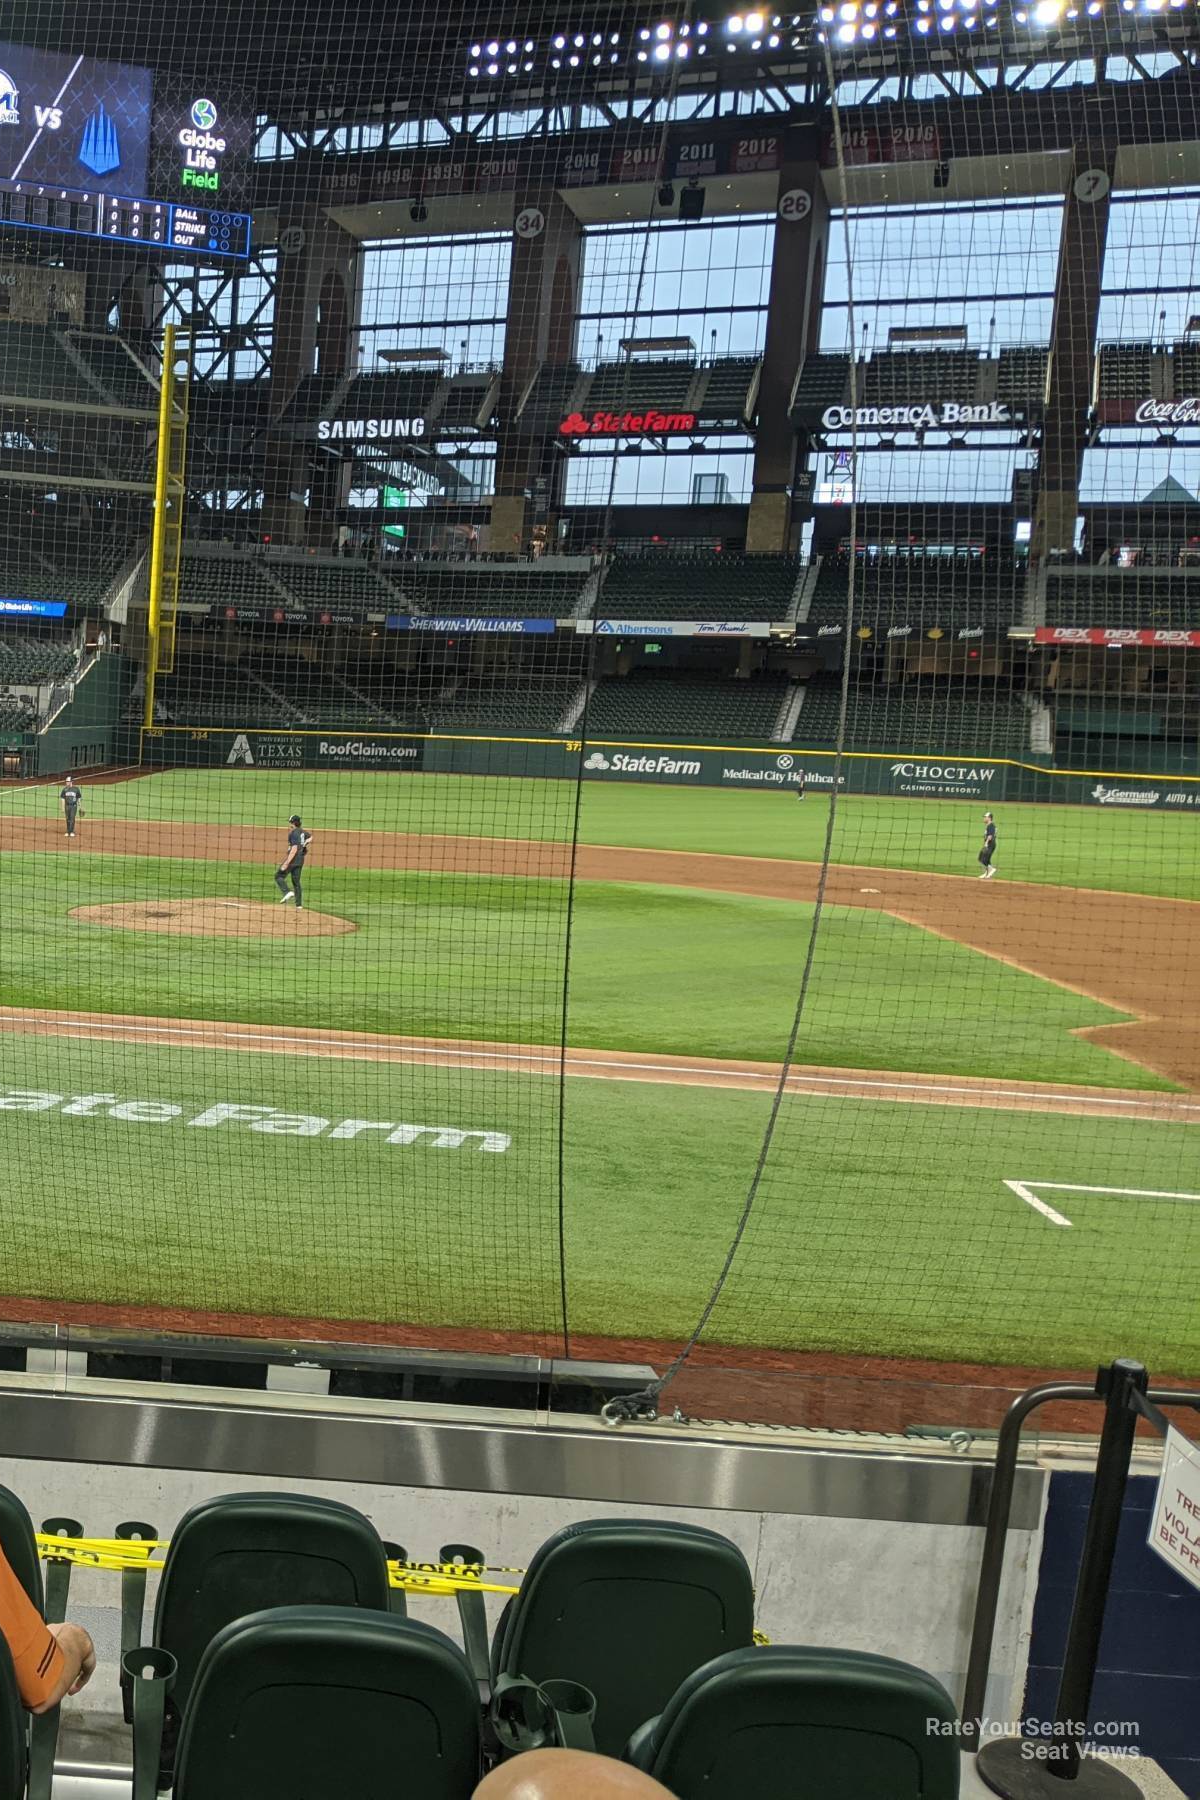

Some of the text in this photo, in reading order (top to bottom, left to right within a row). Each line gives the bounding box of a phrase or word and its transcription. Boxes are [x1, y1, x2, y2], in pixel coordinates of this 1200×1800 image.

[34, 104, 63, 130] VS
[179, 128, 226, 152] Globe
[829, 129, 869, 149] 2015
[893, 125, 935, 144] 2016
[679, 143, 716, 161] 2011
[738, 137, 777, 155] 2012
[186, 148, 217, 170] Life
[481, 159, 517, 176] 2010
[182, 168, 219, 190] Field
[1085, 176, 1100, 196] 7
[15, 183, 22, 192] 6
[38, 187, 44, 195] 7
[61, 190, 67, 198] 8
[83, 193, 89, 202] 9
[112, 198, 118, 207] R
[133, 201, 140, 210] H
[782, 194, 808, 215] 26
[111, 211, 118, 221] 0
[133, 214, 139, 224] 0
[155, 218, 160, 227] 1
[175, 208, 198, 221] BALL
[519, 214, 542, 232] 34
[110, 224, 117, 234] 2
[132, 228, 139, 238] 0
[153, 230, 160, 240] 0
[174, 221, 206, 236] STRIKE
[174, 234, 194, 246] OUT
[941, 401, 1008, 424] Bank
[317, 418, 425, 440] SAMSUNG
[401, 461, 440, 496] BACKYARD
[236, 610, 260, 618] TOYOTA
[284, 613, 308, 621] TOYOTA
[615, 623, 674, 635] Albertsons
[695, 623, 749, 634] Tom Thumb
[1053, 628, 1091, 639] DEX
[1103, 630, 1141, 640] DEX
[1154, 631, 1192, 641] DEX
[258, 745, 302, 757] TEXAS
[319, 741, 418, 758] RoofClaim.com
[258, 760, 302, 768] ARLINGTON
[900, 763, 996, 782] CHOCTAW
[722, 768, 846, 785] Medical City Helthcae
[900, 784, 936, 792] CASINOS
[945, 786, 981, 794] RESORTS
[1111, 788, 1160, 800] Germania
[1165, 793, 1186, 804] AUTO
[1186, 795, 1194, 804] &
[1159, 1524, 1178, 1551] BE
